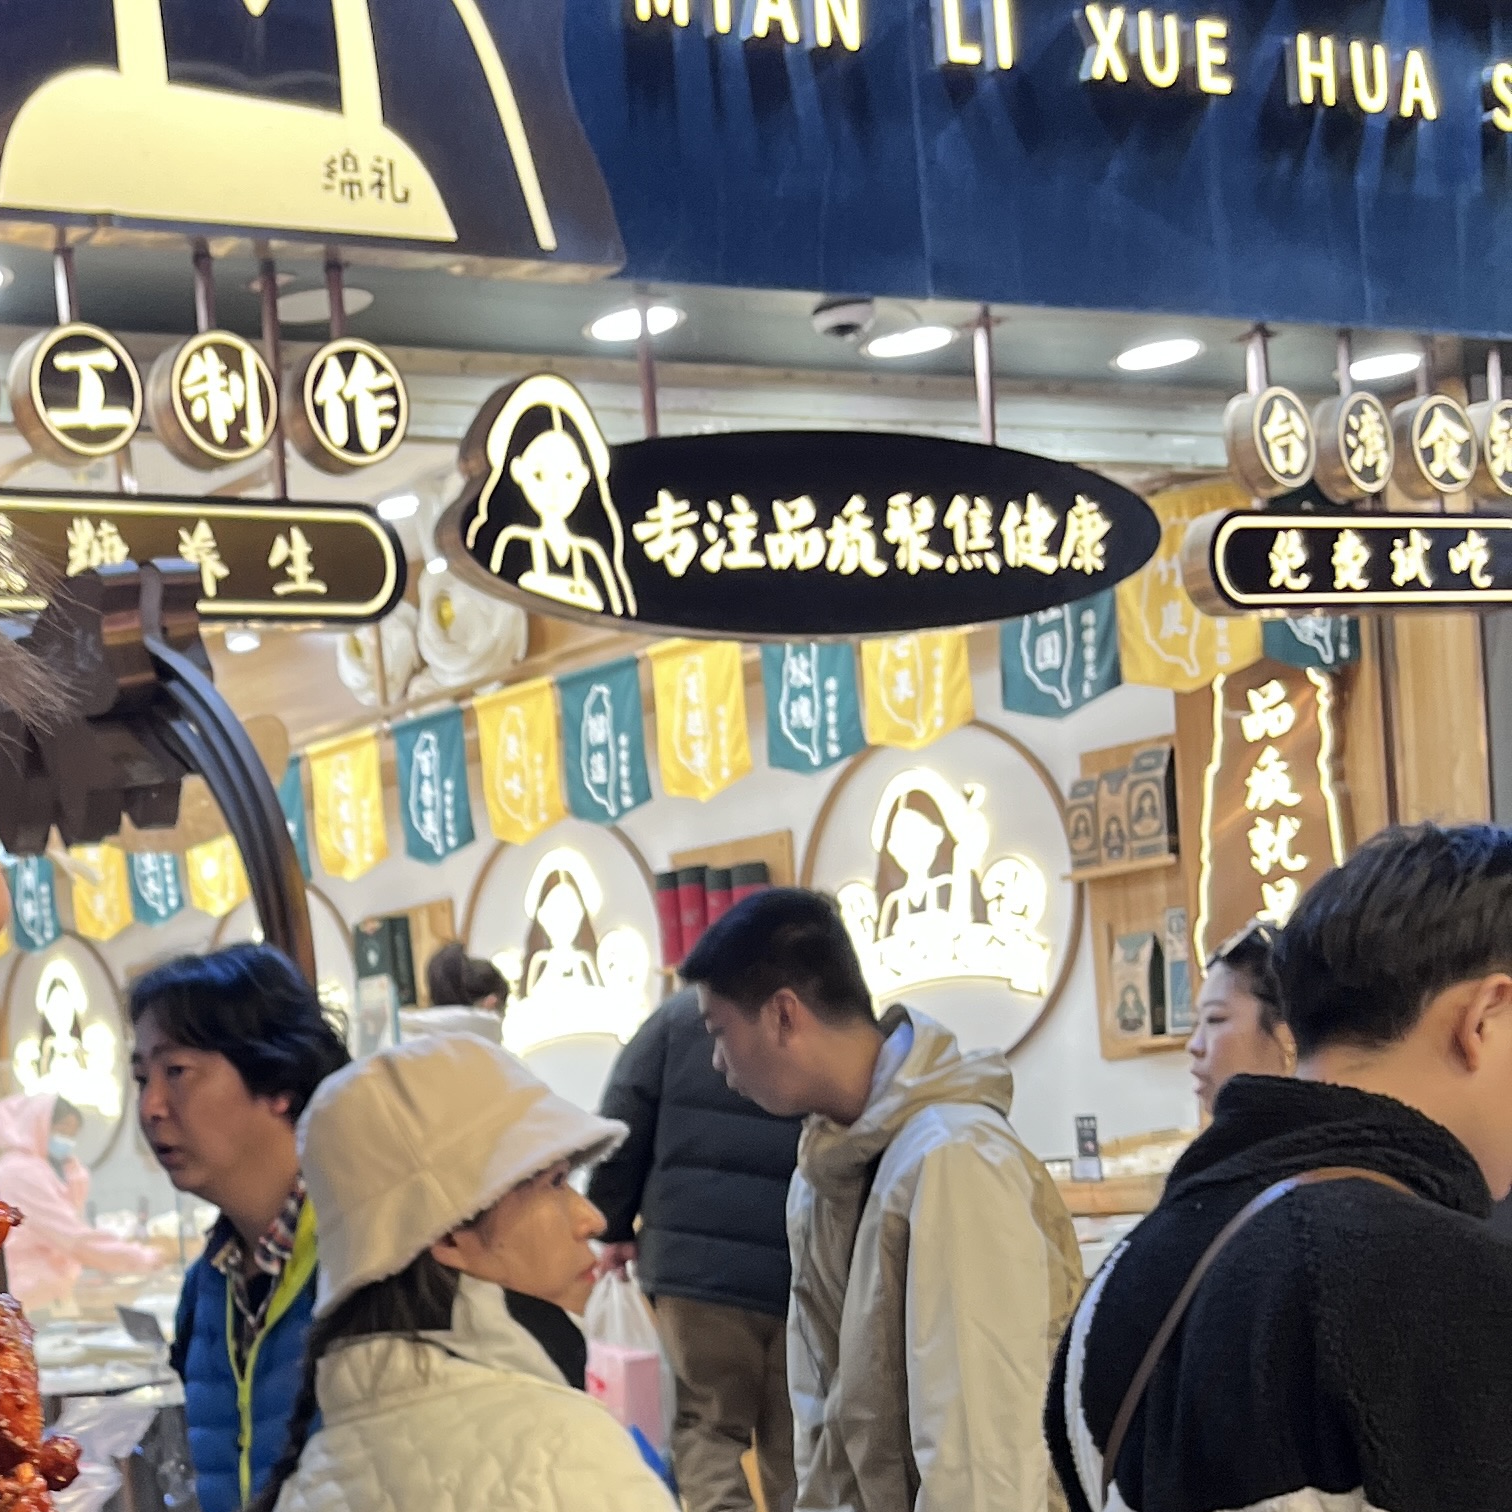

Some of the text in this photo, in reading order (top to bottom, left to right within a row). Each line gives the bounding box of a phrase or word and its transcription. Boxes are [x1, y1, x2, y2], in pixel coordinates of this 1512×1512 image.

[943, 0, 1013, 70] LI
[1085, 4, 1233, 95] XUE
[1296, 32, 1437, 120] HUA
[322, 148, 410, 204] 绵礼
[633, 489, 1113, 578] 专注品质聚焦健康
[1268, 528, 1494, 591] 免费试吃
